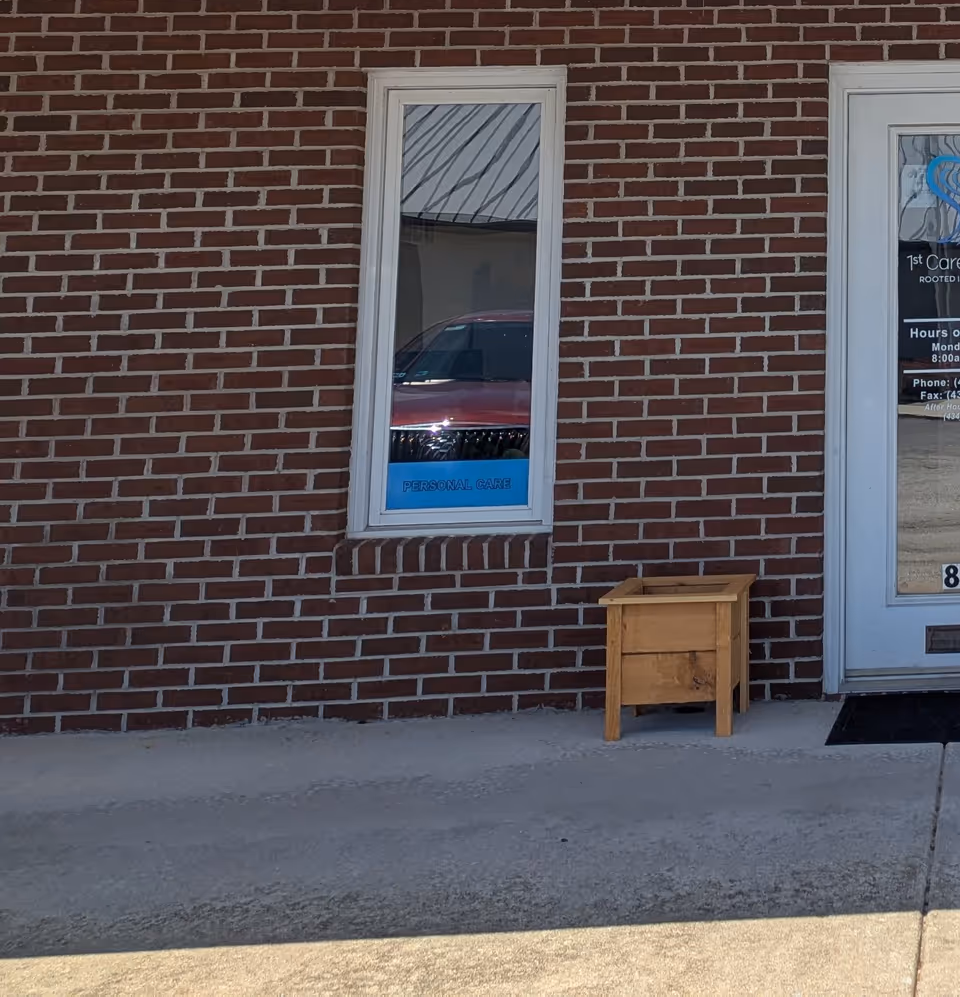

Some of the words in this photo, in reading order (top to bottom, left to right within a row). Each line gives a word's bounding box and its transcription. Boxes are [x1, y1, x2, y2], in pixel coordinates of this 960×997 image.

[907, 254, 922, 271] 1st
[920, 275, 956, 283] ROOTED
[910, 328, 948, 338] Hours
[913, 379, 950, 387] Phone:
[920, 391, 942, 400] Fax:
[925, 403, 944, 411] After
[403, 479, 472, 492] PERSONAL
[476, 478, 511, 490] CARE
